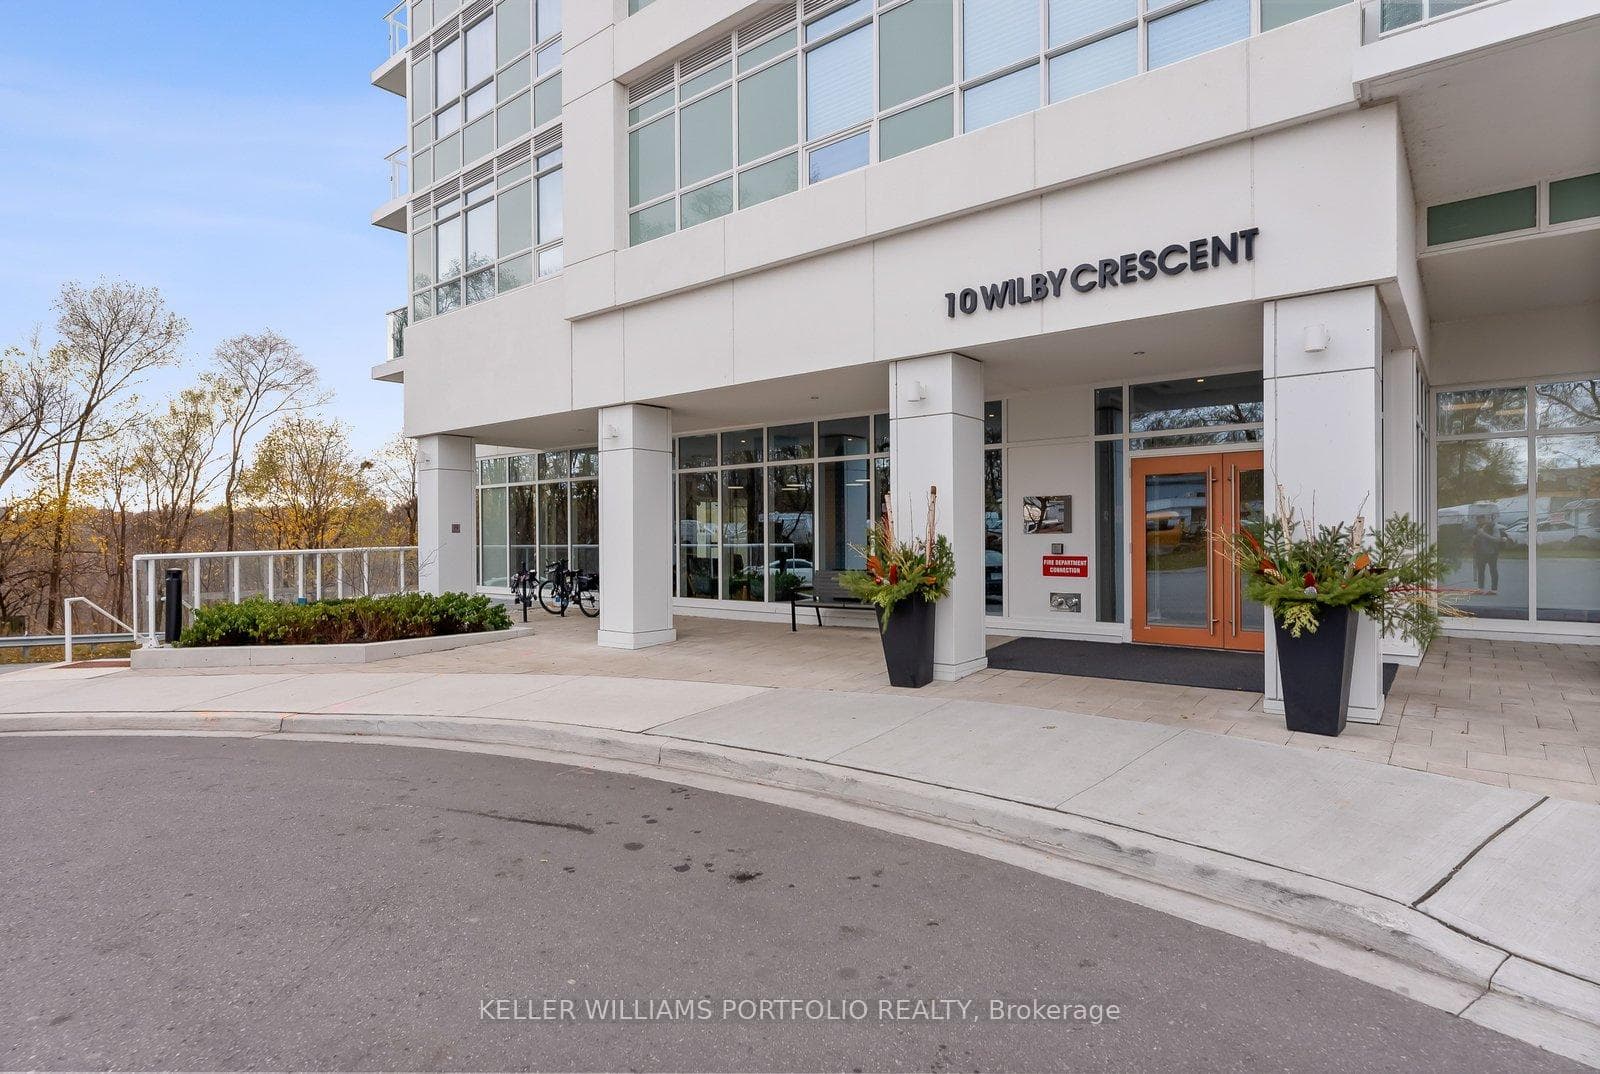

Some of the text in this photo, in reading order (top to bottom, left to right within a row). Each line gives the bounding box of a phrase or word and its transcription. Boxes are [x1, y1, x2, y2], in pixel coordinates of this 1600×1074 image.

[944, 227, 1260, 318] 10 WILBY CRESCENT
